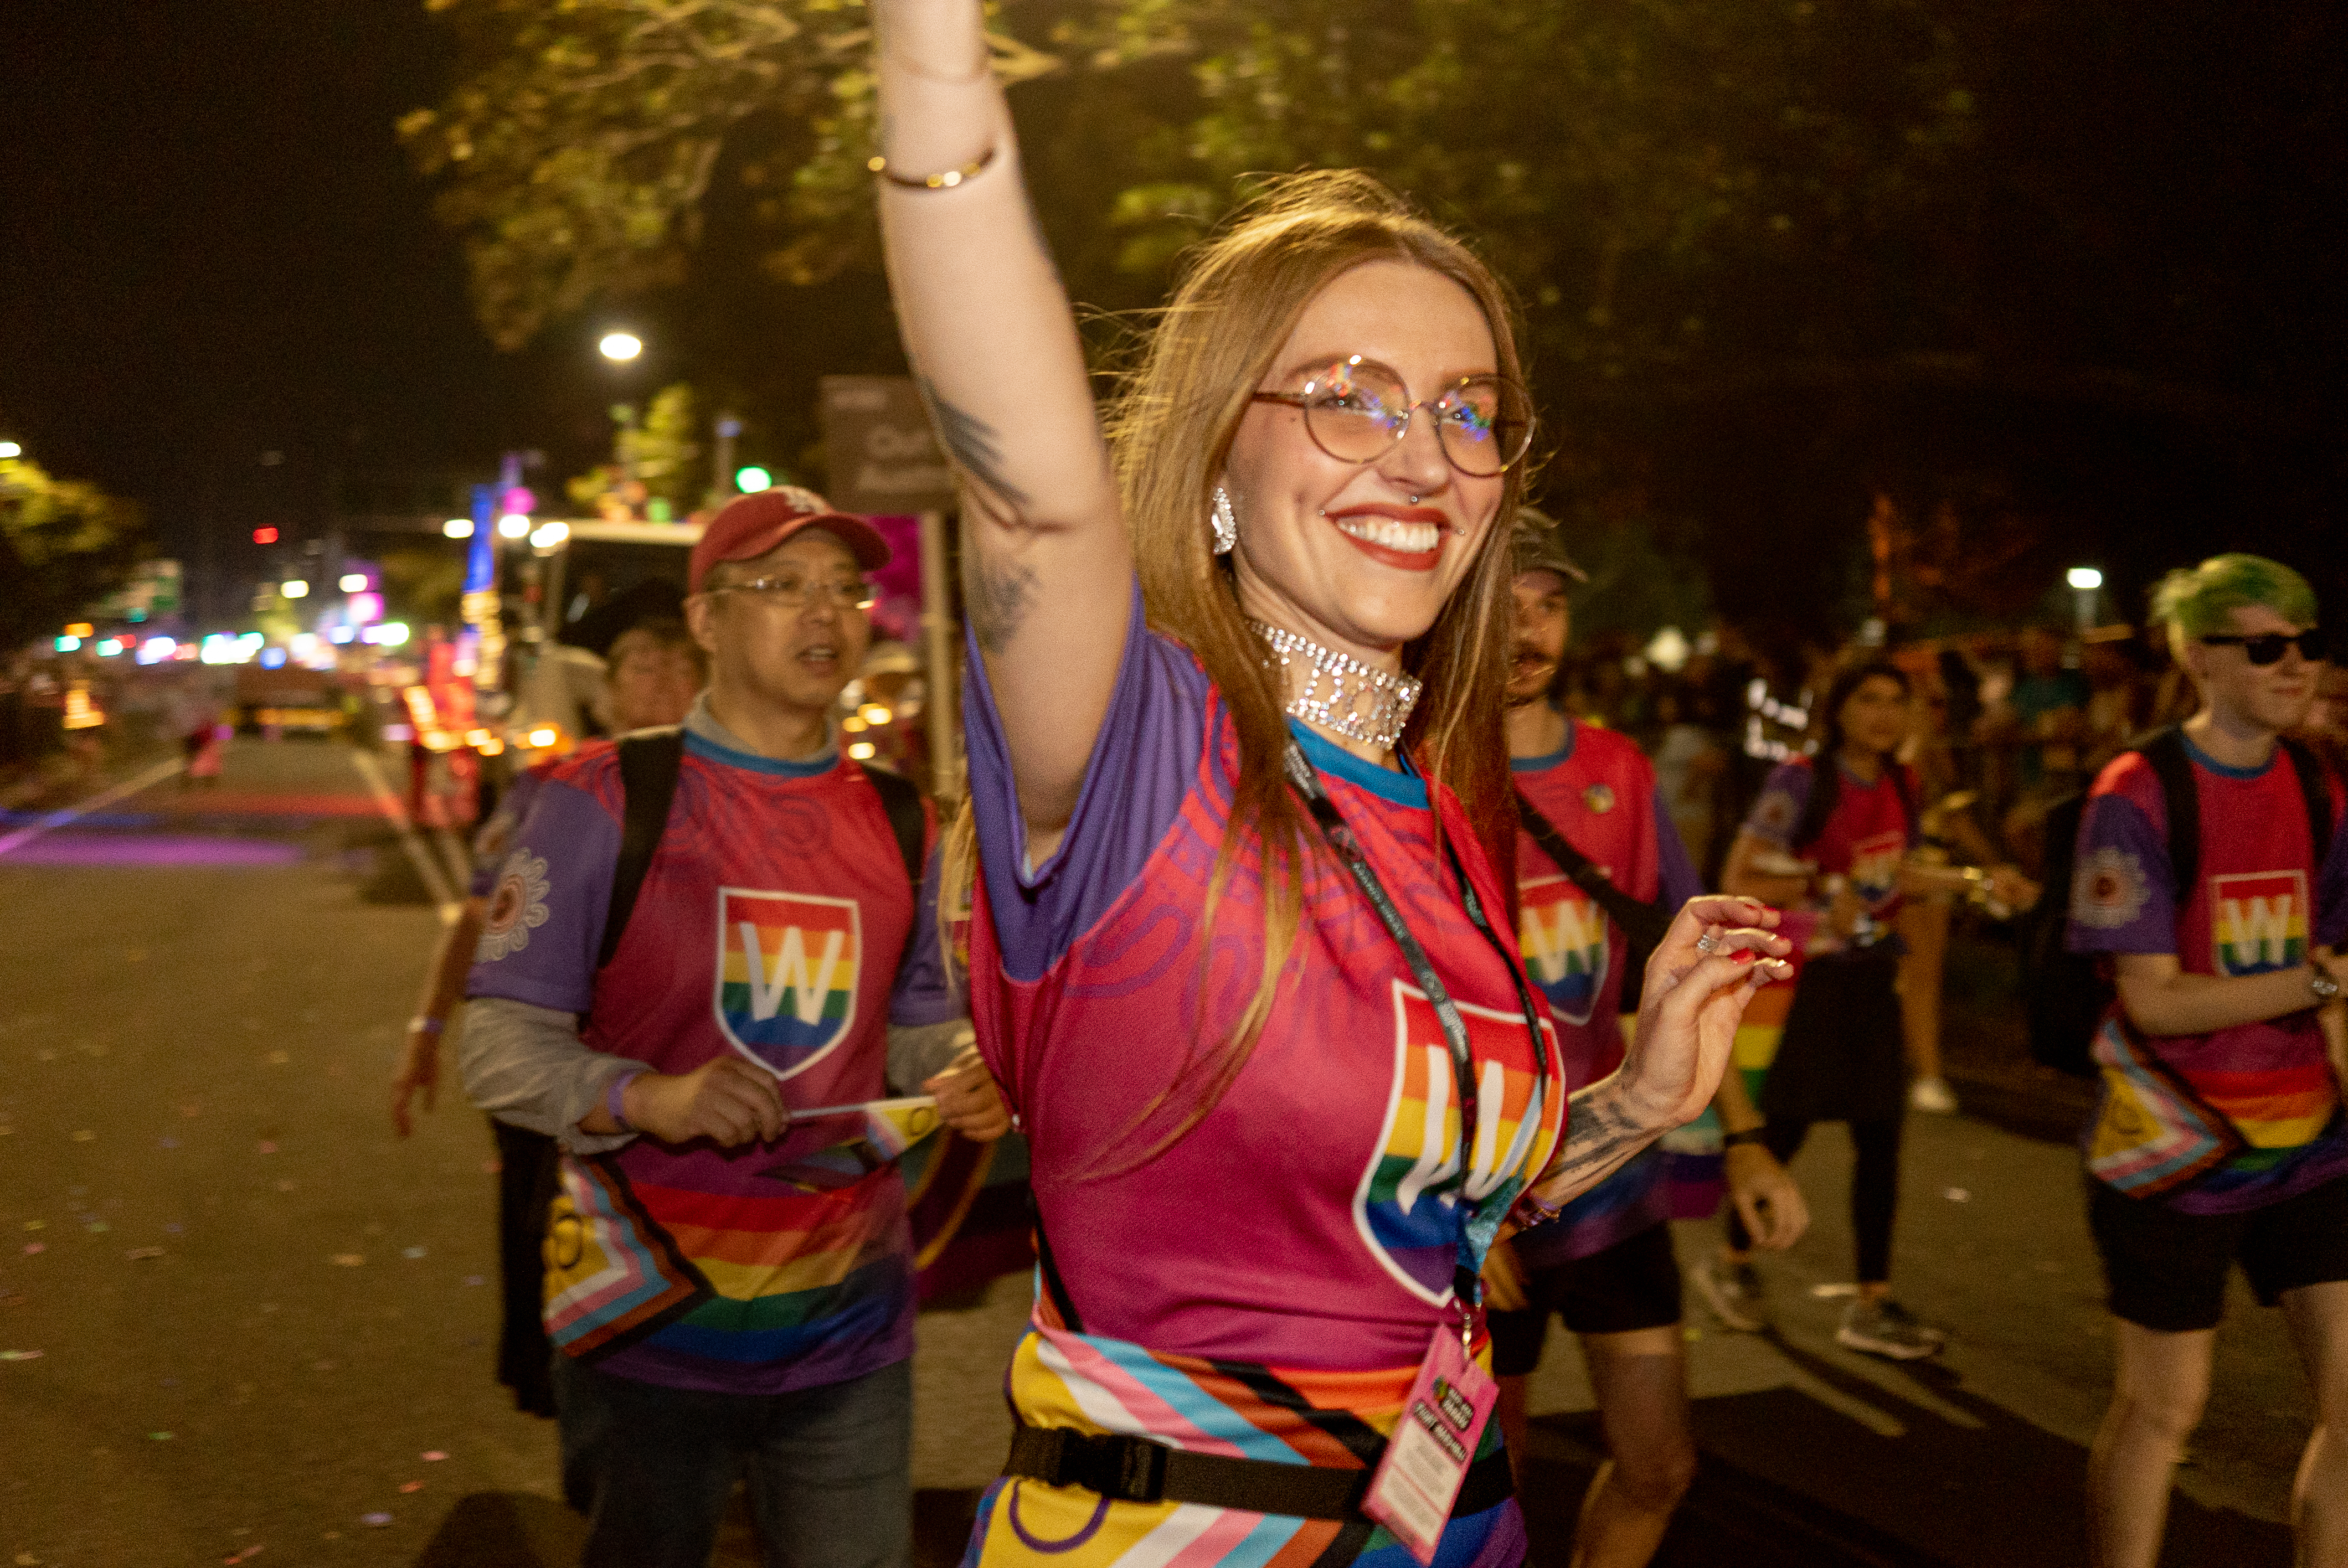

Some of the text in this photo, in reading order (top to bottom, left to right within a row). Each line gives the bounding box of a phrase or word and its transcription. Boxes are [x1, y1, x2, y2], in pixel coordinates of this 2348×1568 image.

[1521, 898, 1599, 984] W
[2225, 893, 2292, 966] W
[738, 921, 845, 1027] W
